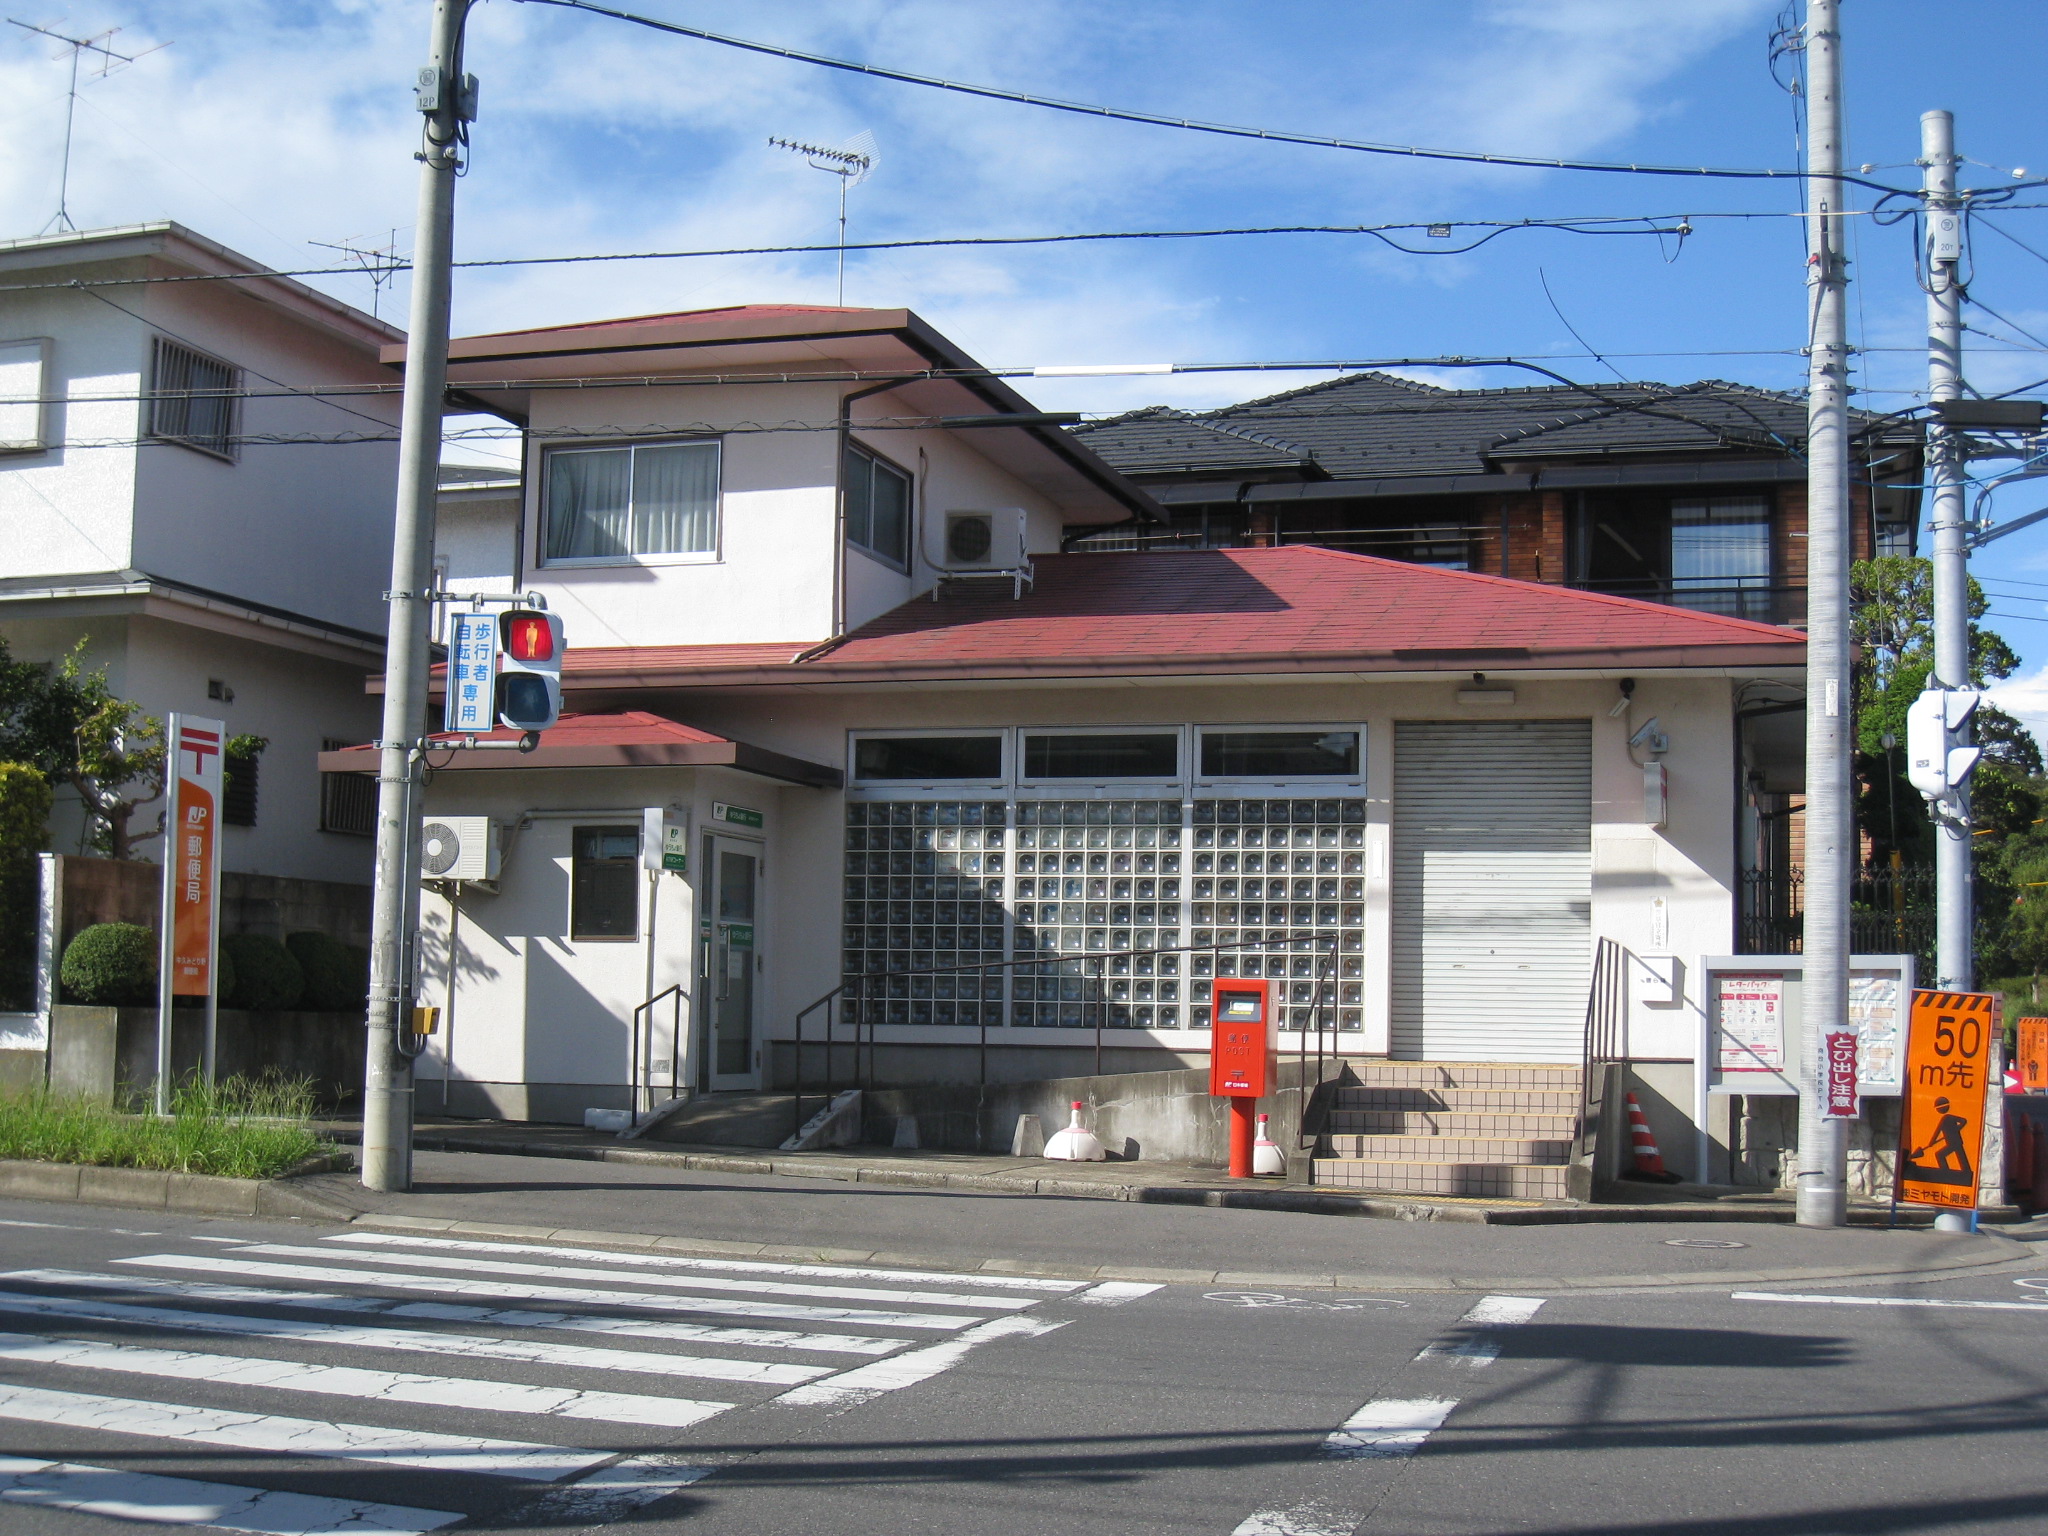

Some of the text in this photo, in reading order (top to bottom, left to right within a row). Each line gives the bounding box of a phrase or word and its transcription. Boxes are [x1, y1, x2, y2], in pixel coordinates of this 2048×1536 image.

[418, 96, 435, 108] 12P
[1941, 243, 1953, 251] 20T
[455, 624, 472, 681] 自転車
[472, 622, 491, 682] 歩行者
[461, 684, 478, 723] 専用
[186, 835, 203, 904] 郵便局
[1933, 1015, 1981, 1059] 50
[1831, 1036, 1853, 1108] とび出し注意
[1919, 1060, 1974, 1089] m先
